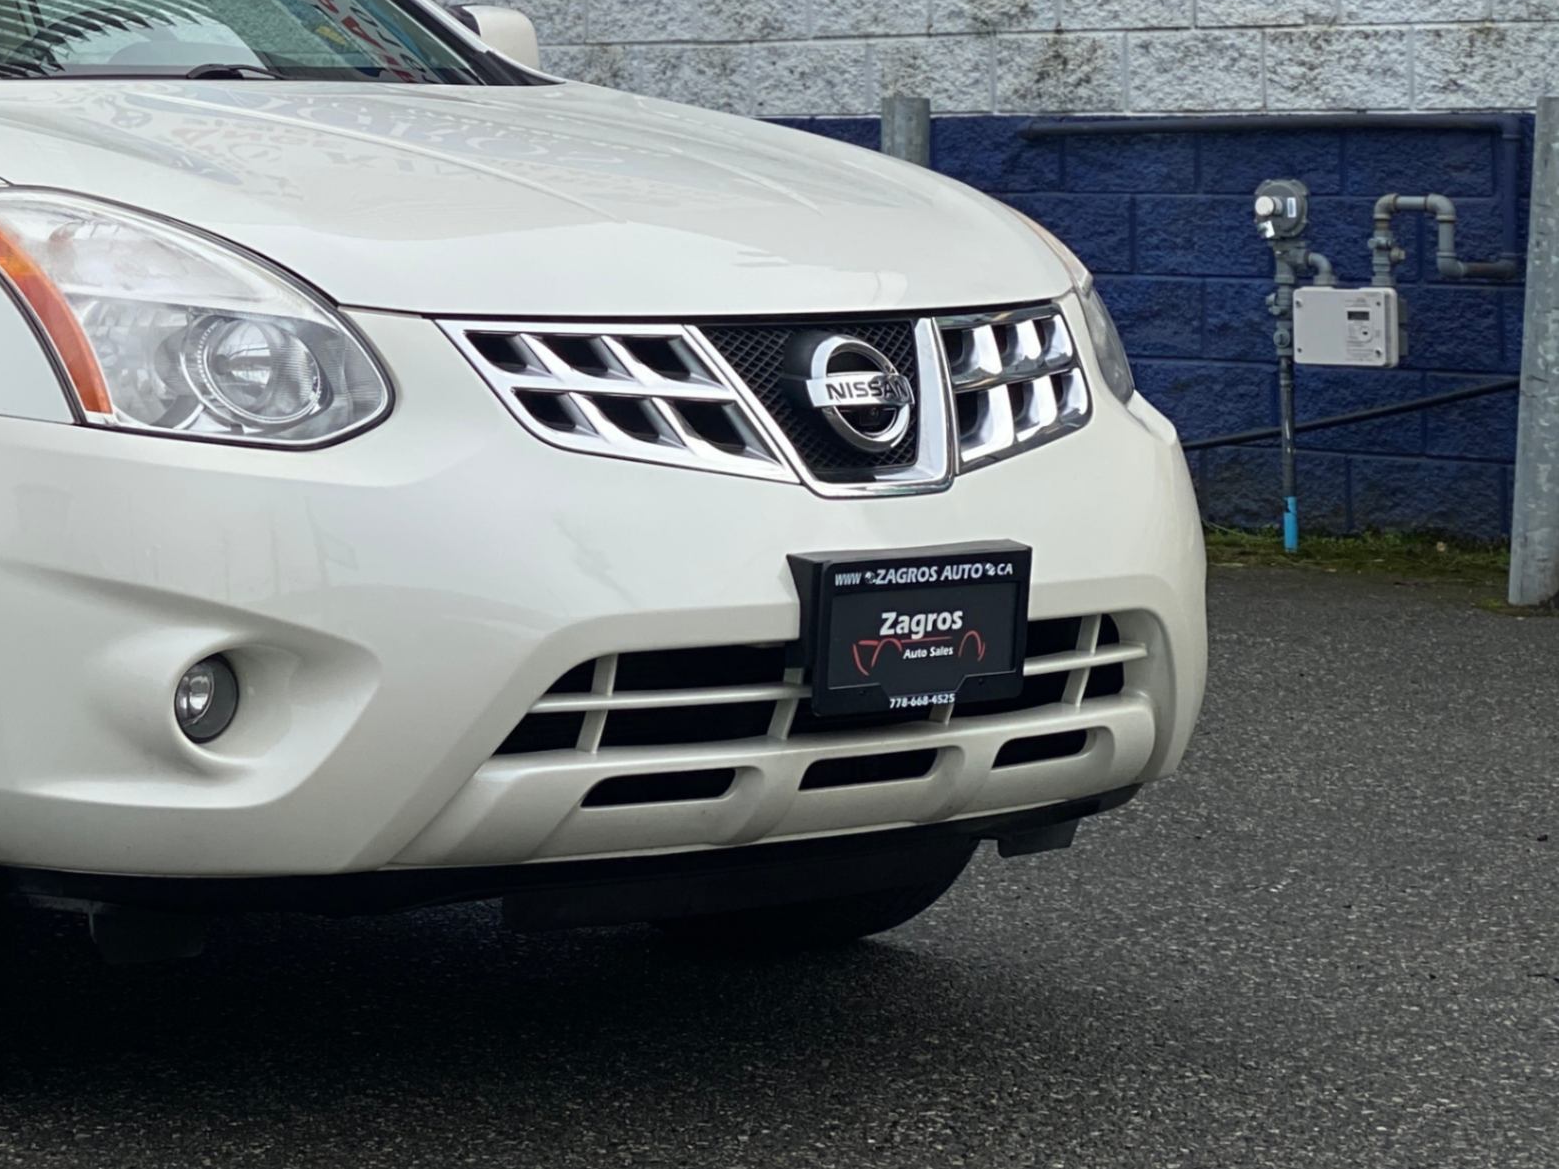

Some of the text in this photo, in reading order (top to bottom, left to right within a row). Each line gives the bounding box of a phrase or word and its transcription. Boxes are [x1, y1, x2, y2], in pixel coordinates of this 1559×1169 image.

[825, 380, 910, 405] NISSAN
[874, 566, 939, 585] ZAGROS
[940, 563, 983, 582] AUTO
[996, 563, 1014, 576] CA
[879, 610, 964, 640] Zagros
[902, 645, 954, 660] Auto Sales
[889, 693, 956, 709] 778-668-4525
